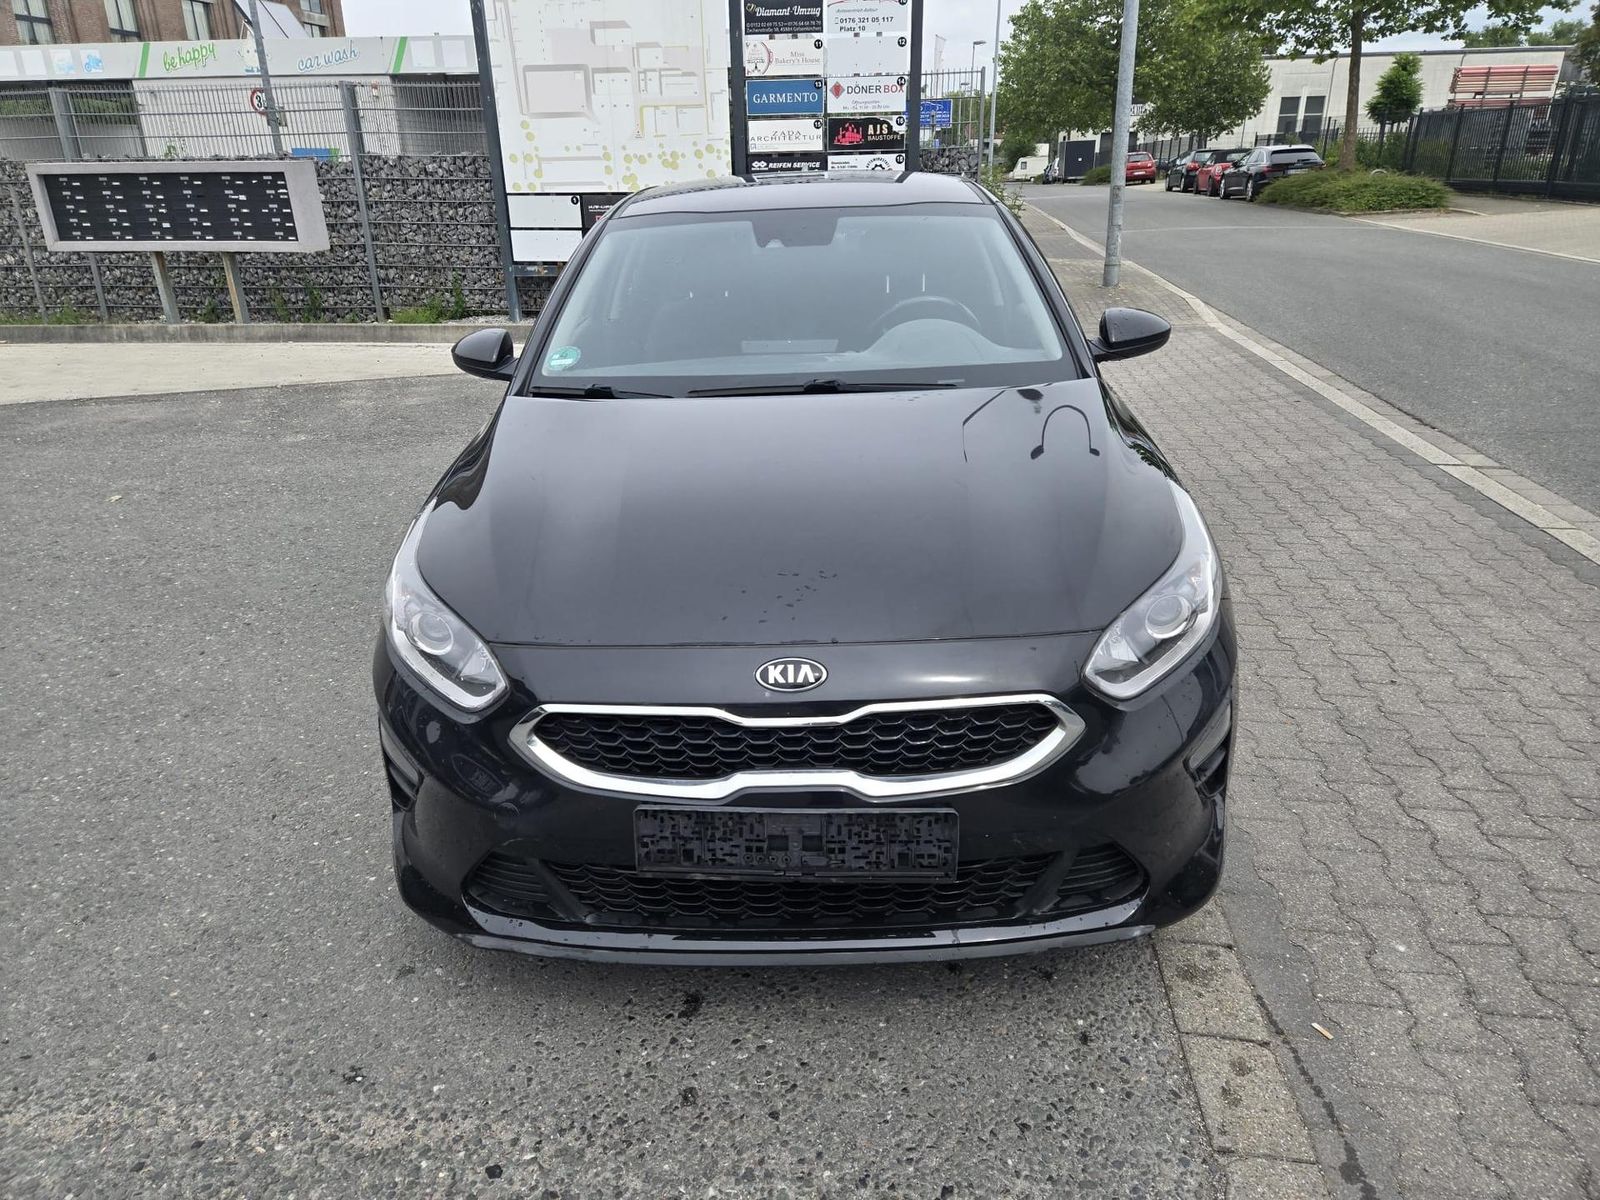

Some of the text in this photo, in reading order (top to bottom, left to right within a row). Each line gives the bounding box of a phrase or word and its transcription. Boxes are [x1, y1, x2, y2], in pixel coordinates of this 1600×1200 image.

[756, 5, 821, 17] Diamant-Umzug
[163, 42, 216, 72] be happy
[297, 42, 358, 72] car wash
[846, 84, 904, 95] DÖNER BOX
[753, 92, 818, 103] GARMENTO
[867, 123, 888, 135] AJS
[750, 134, 822, 142] ARCHITEKTUR
[767, 664, 816, 684] KIA
